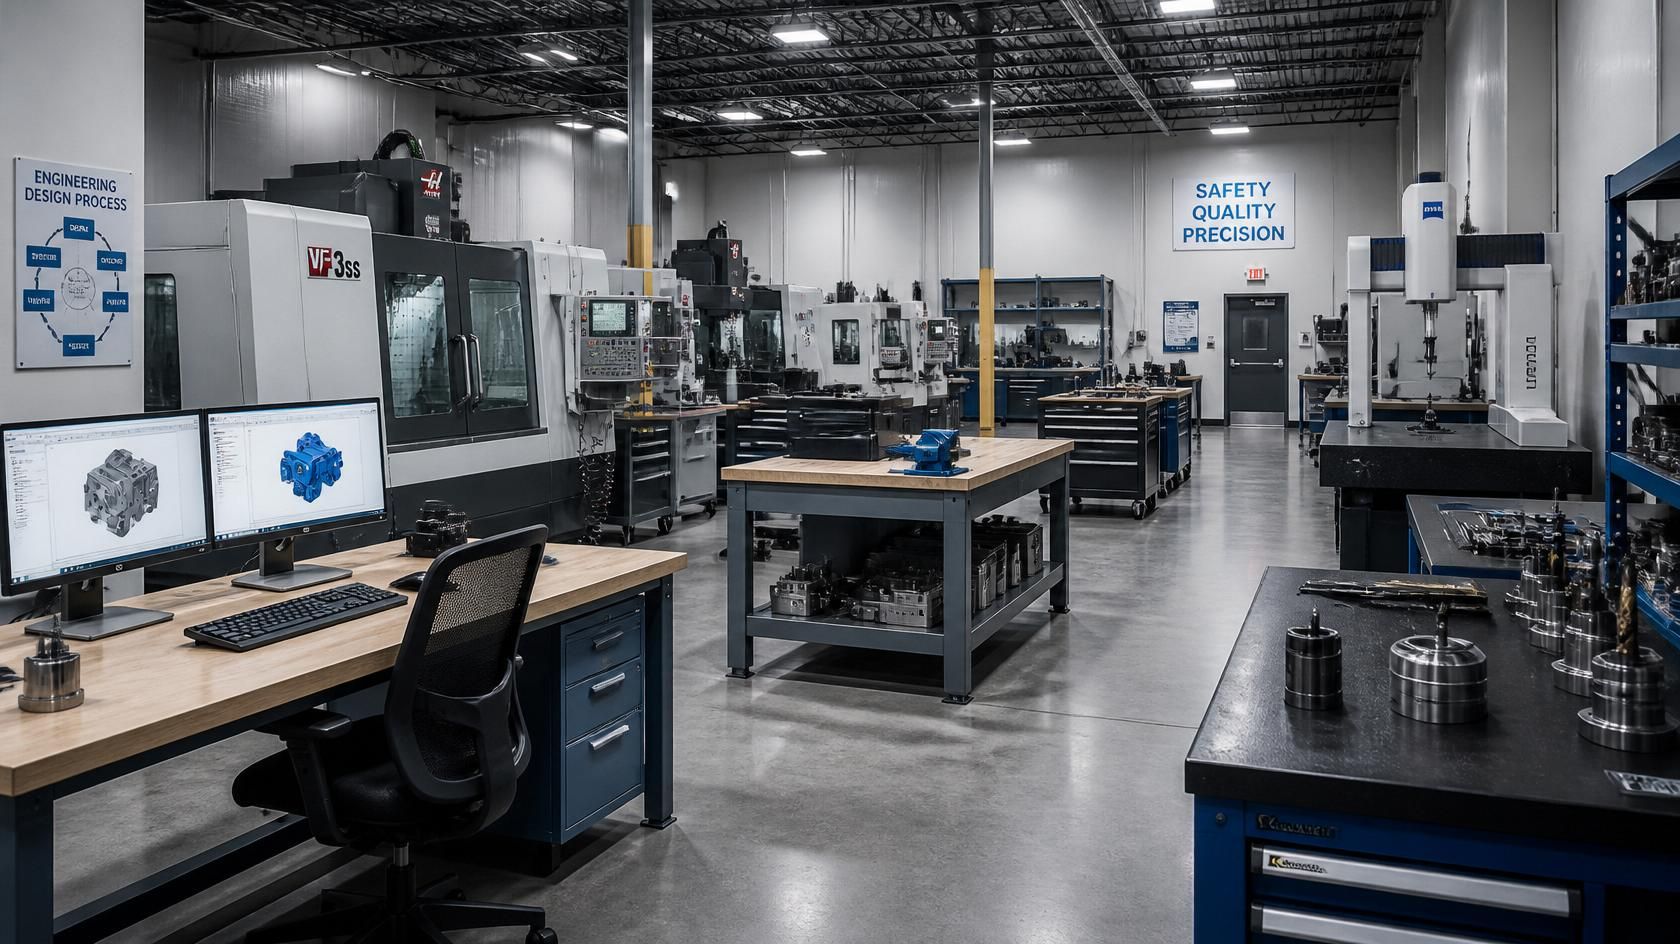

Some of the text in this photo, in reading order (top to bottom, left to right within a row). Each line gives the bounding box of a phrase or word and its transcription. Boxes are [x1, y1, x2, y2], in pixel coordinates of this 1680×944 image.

[34, 169, 117, 193] ENGINEERING
[1196, 181, 1271, 199] SAFETY
[24, 187, 127, 212] DESIGN PROCESS
[1192, 203, 1276, 222] QUALITY
[1183, 225, 1285, 243] PRECISION
